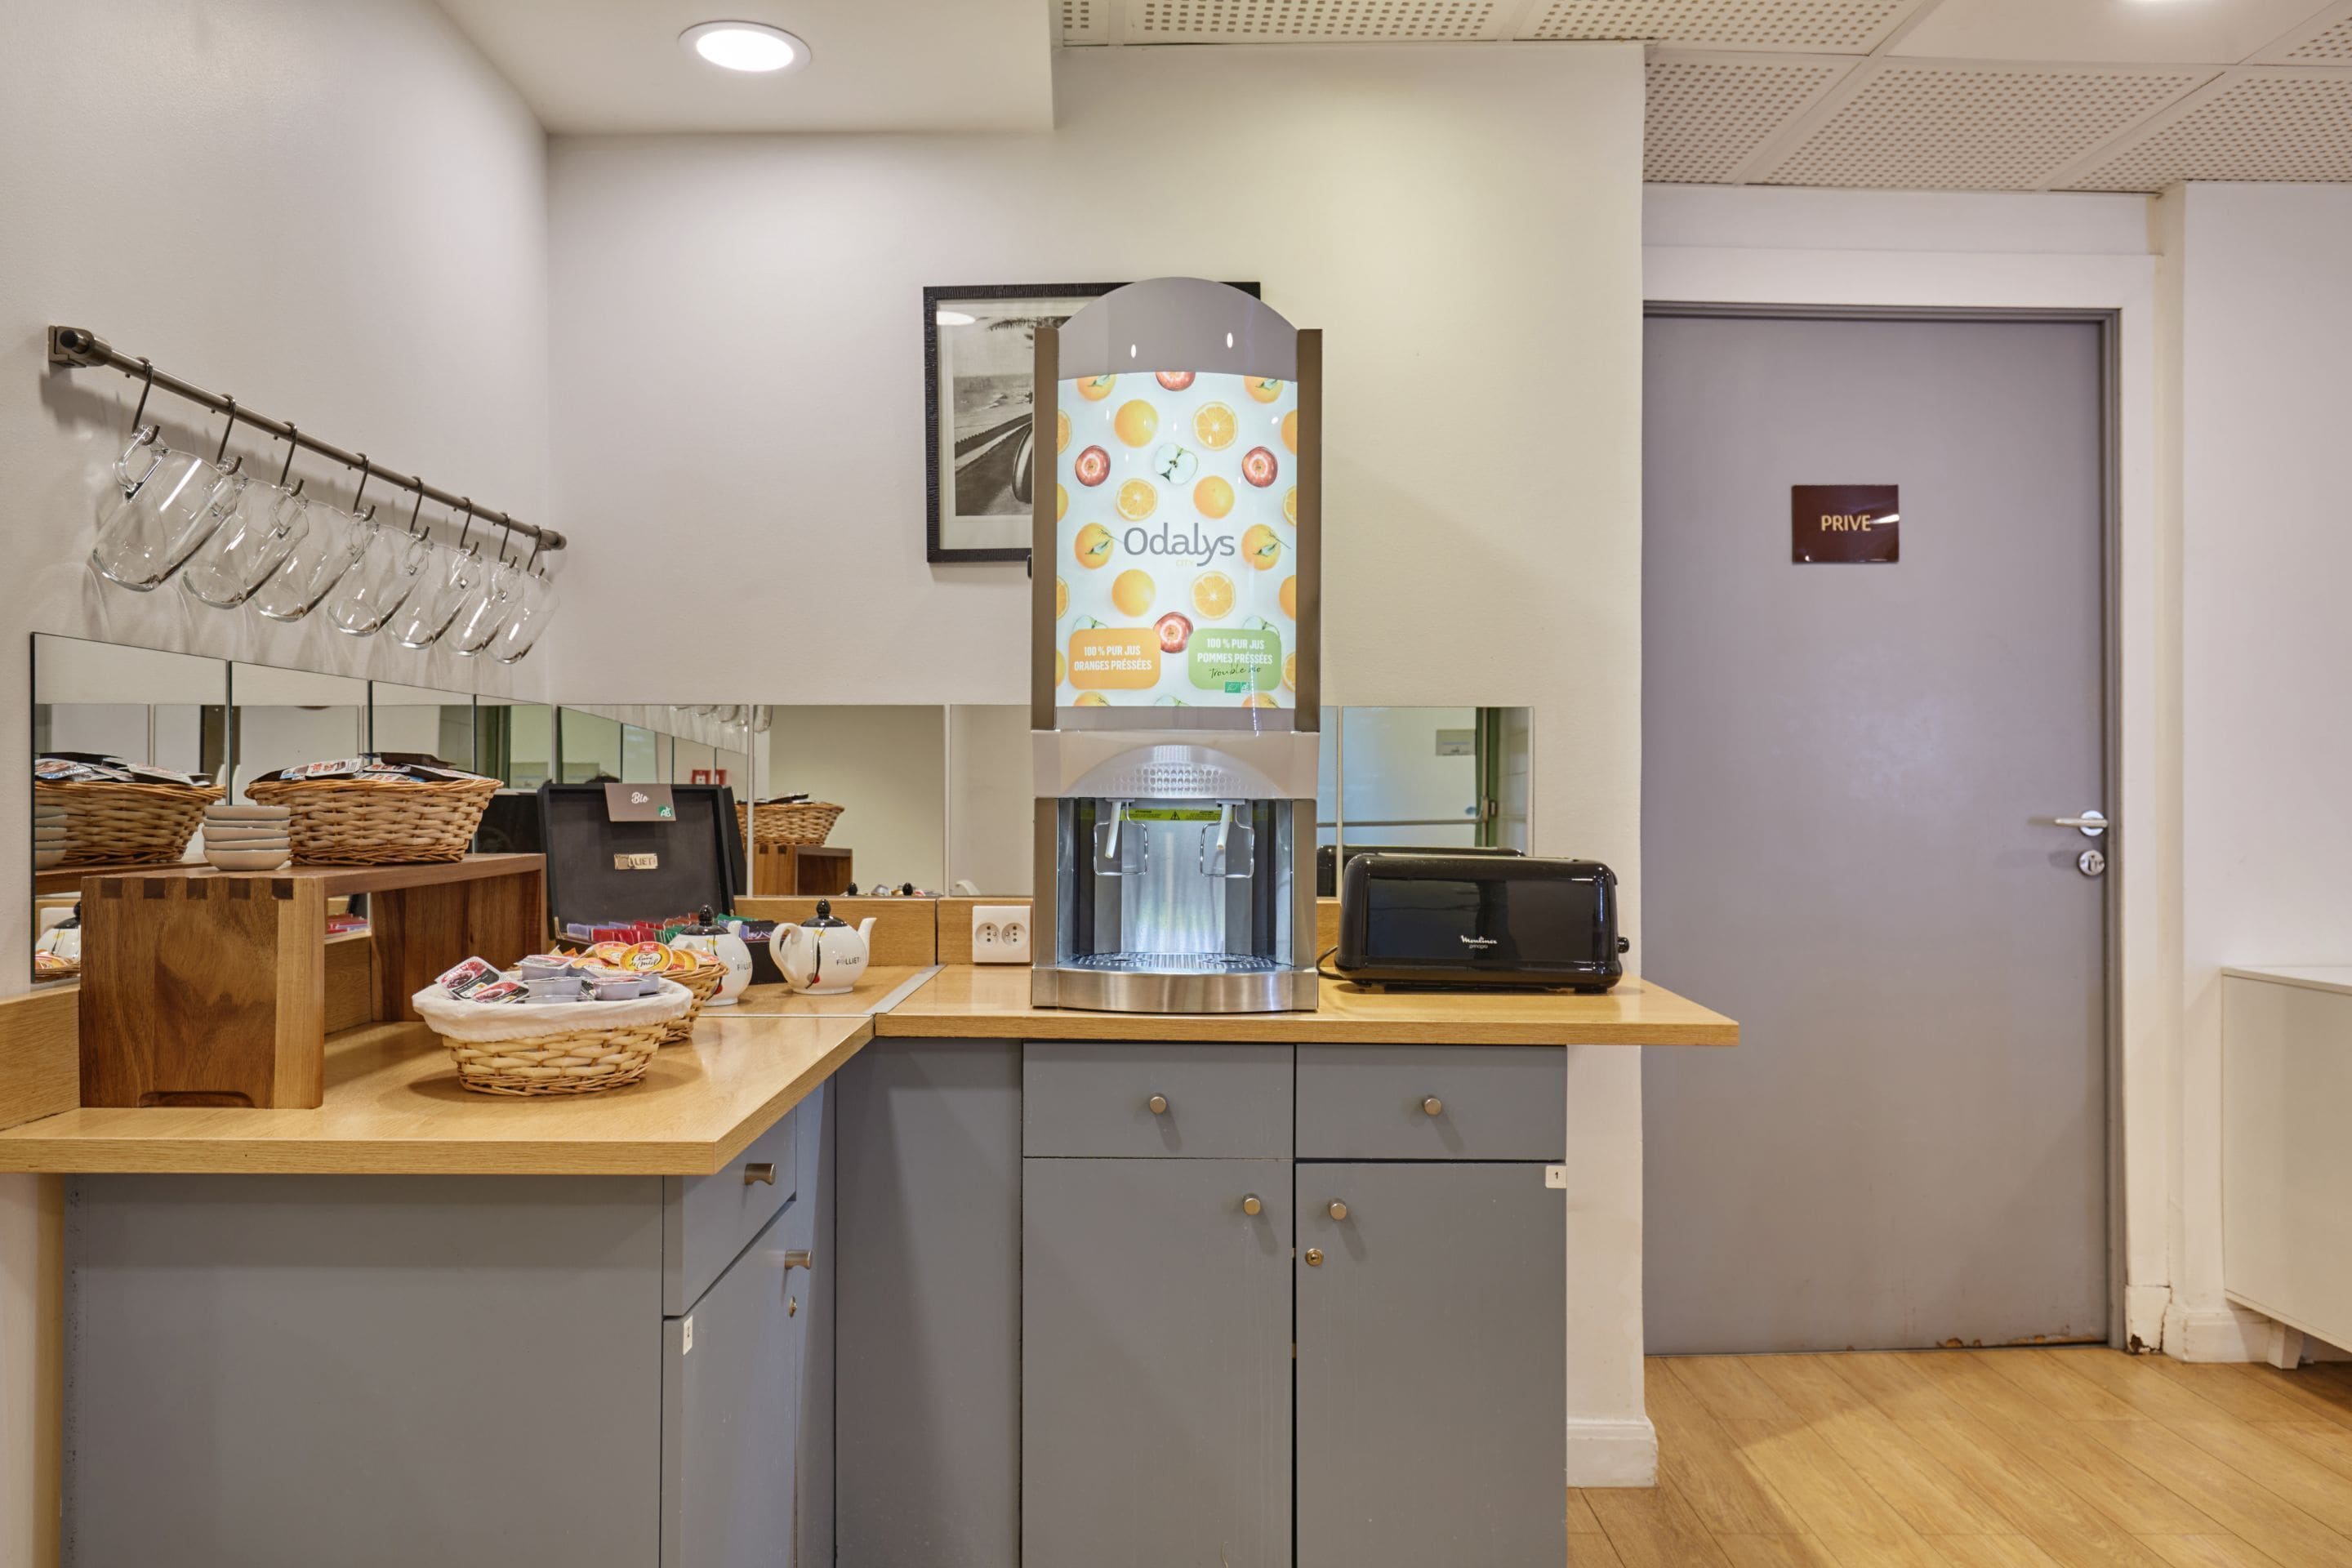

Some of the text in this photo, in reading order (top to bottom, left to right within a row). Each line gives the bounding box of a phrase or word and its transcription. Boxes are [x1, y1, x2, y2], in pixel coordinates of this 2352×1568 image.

[1820, 514, 1871, 532] PRIVE
[1124, 522, 1235, 567] Odalys
[1206, 639, 1265, 649] 100 % PUR JUS
[1084, 645, 1141, 656] 100 % PUR JUS
[1074, 657, 1152, 670] ORANGES PRÉSSÉES
[1197, 653, 1232, 663] POMMES
[631, 791, 649, 804] Bio
[1554, 1171, 1559, 1180] 1
